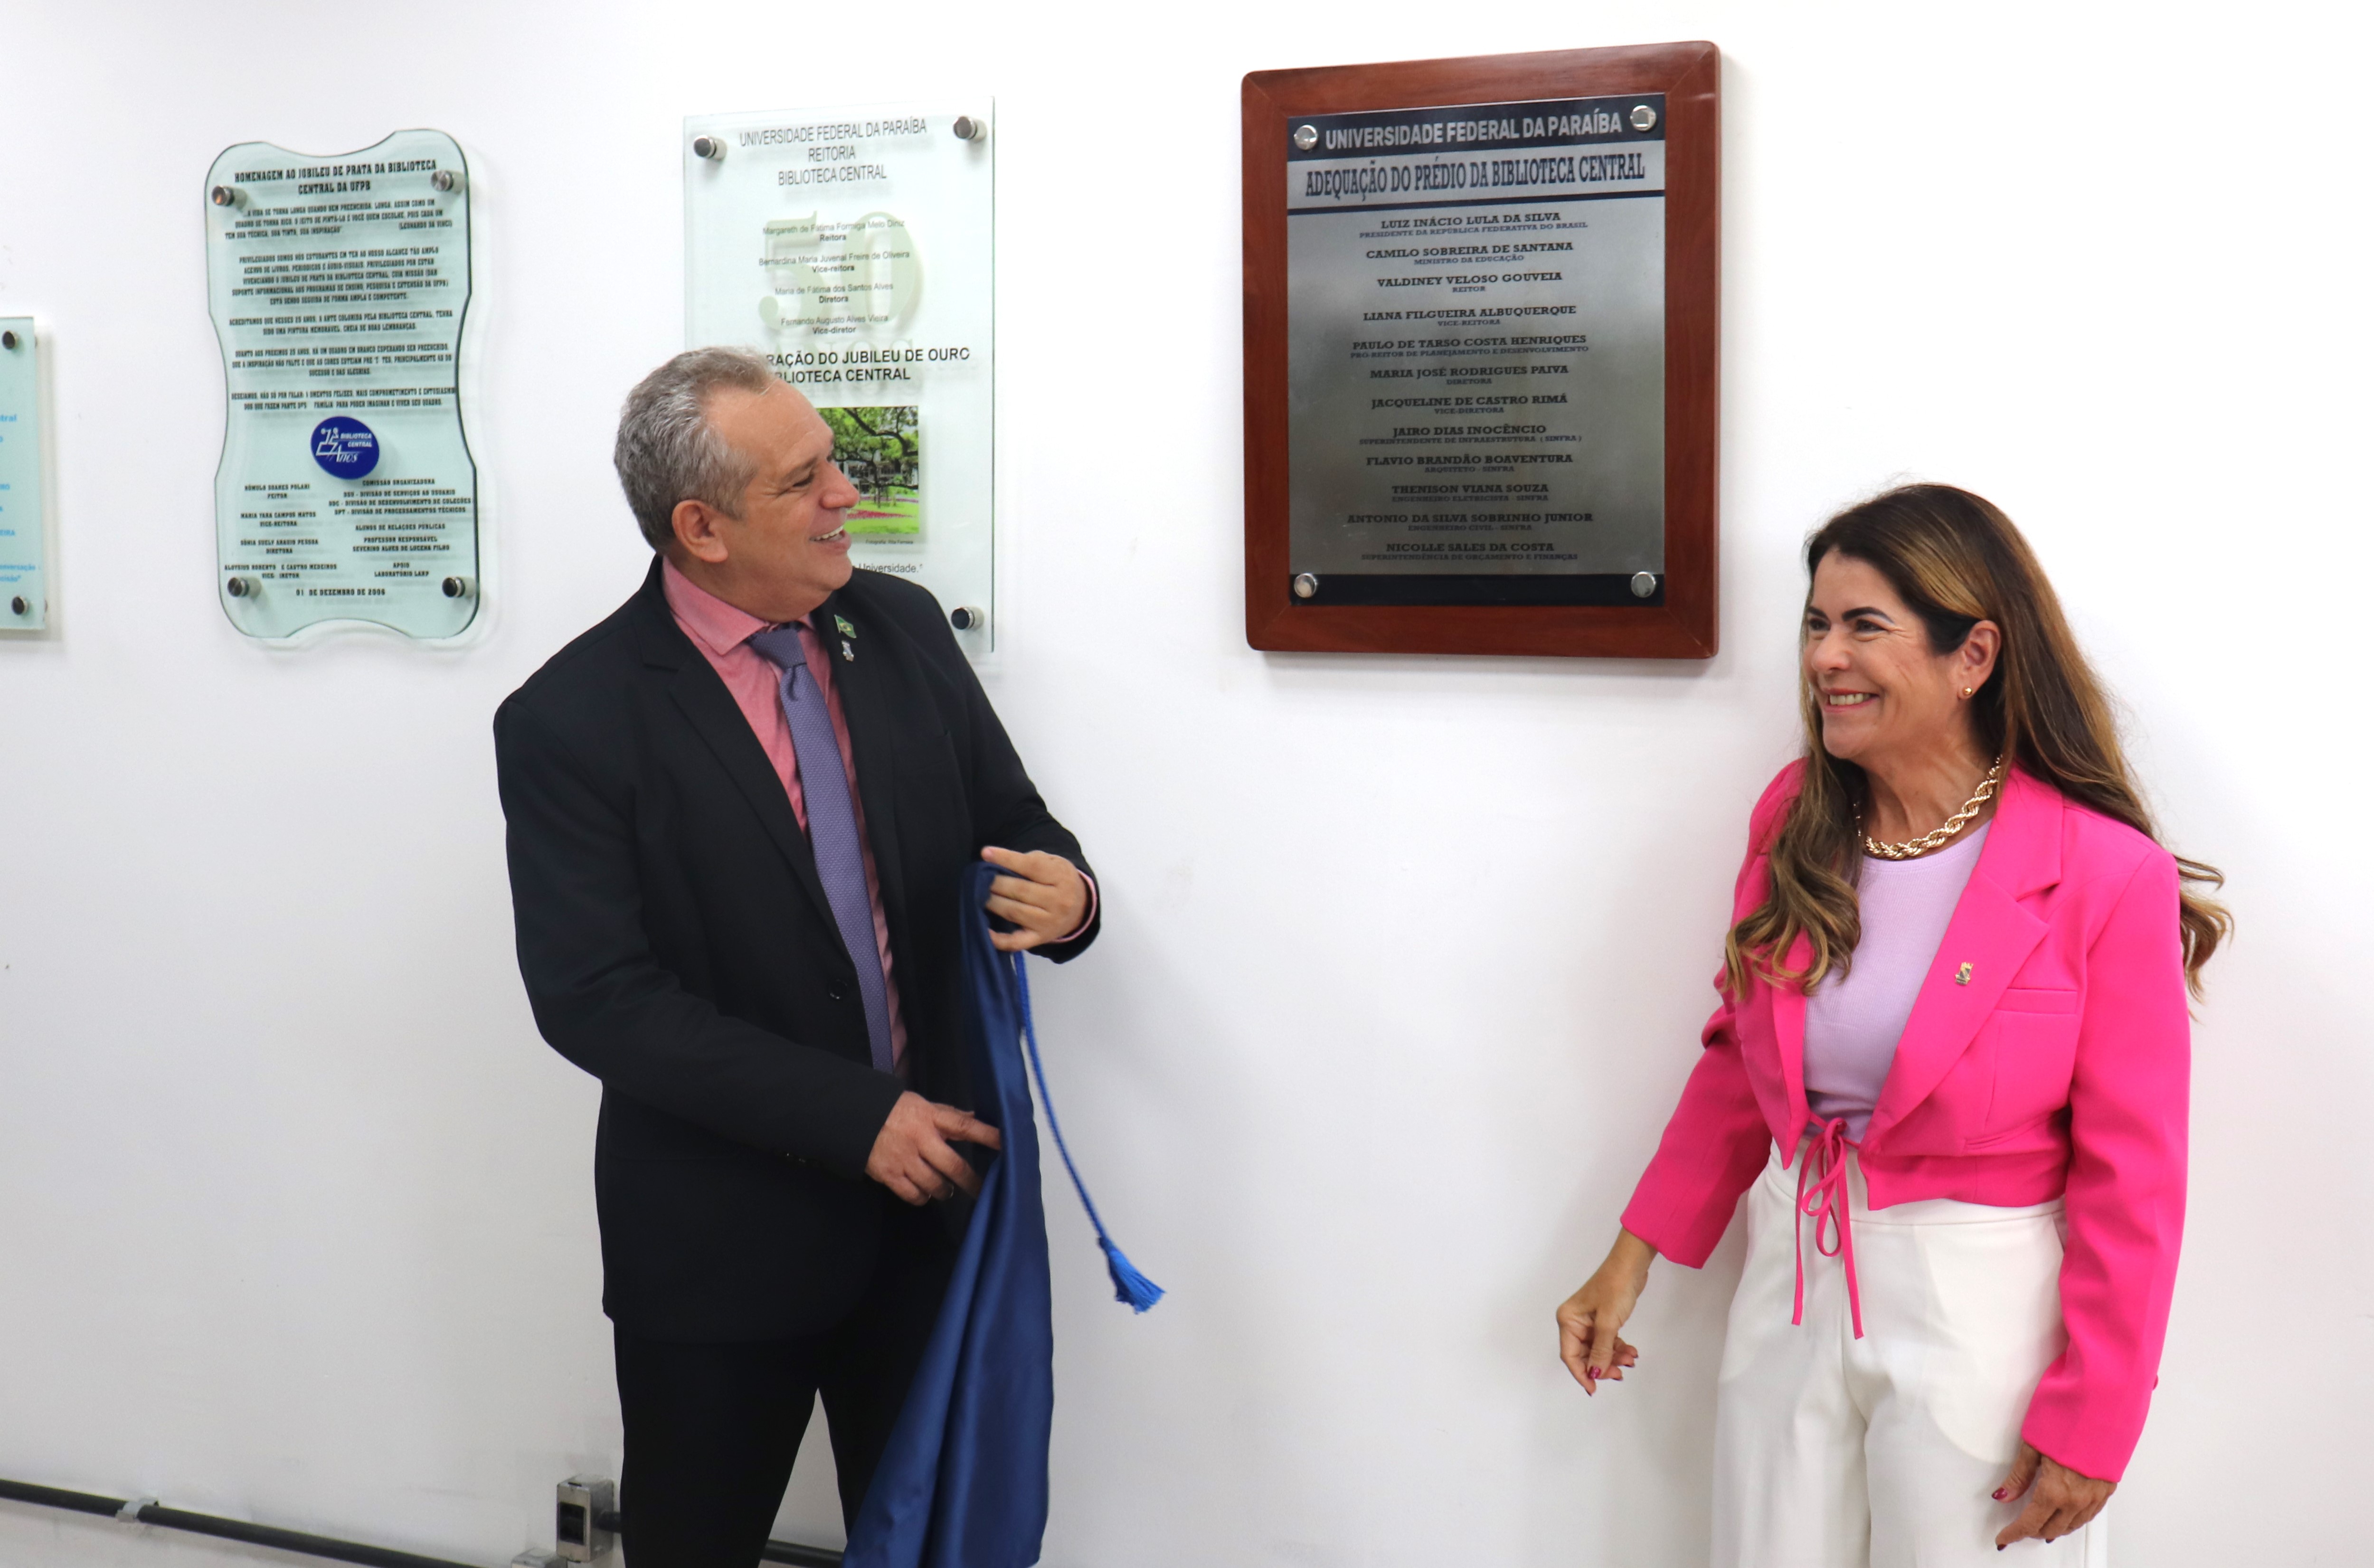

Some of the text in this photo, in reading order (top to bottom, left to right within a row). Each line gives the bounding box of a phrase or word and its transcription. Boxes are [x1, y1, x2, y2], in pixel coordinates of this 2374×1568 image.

[739, 116, 927, 147] UNIVERSIDADE FEDERAL DA PARAÍBA
[1326, 108, 1622, 150] UNIVERSIDADE FEDERAL DA PARAÍBA
[808, 145, 856, 162] REITORIA
[235, 170, 283, 183] HOMENAGEM
[286, 169, 295, 179] AO
[333, 166, 343, 176] DE
[346, 164, 371, 175] PRATA
[375, 163, 385, 174] DA
[388, 160, 436, 173] BIBLIOTECA
[778, 165, 886, 186] BIBLIOTECA CENTRAL
[1306, 152, 1645, 201] ADEQUAÇÃO DO PRÉDIO DA BIBLIOTECA CENTRAL
[298, 183, 334, 195] CENTRAL
[337, 182, 347, 192] DA
[1381, 212, 1561, 229] LUIZ INÁCIO LULA DA SILVA
[1359, 230, 1413, 238] PRESIDENTE
[1482, 224, 1537, 232] FEDERATIVA
[1366, 242, 1573, 259] CAMILO SOBREIRA DE SANTANA
[1475, 254, 1524, 263] EDUCAÇÃO
[812, 265, 855, 273] Vice-reitora
[1378, 272, 1562, 287] VALDINEY VELOSO GOUVEIA
[807, 285, 831, 293] Fátima
[848, 283, 871, 292] Santos
[819, 295, 849, 303] Diretora
[1363, 305, 1576, 321] LIANA FILGUEIRA ALBUQUERQUE
[781, 318, 815, 326] Fernando
[816, 317, 845, 326] Augusto
[812, 326, 856, 334] Vice-diretor
[1353, 335, 1586, 349] PAULO DE TARSO COSTA HENRIQUES
[818, 351, 838, 365] DO
[842, 350, 900, 364] JUBILEU
[905, 349, 923, 362] DE
[1420, 349, 1490, 357] PLANEJAMENTO
[1500, 346, 1589, 354] DESENVOLVIMENTO
[775, 368, 910, 383] LIOTECA CENTRAL
[1370, 365, 1569, 379] MARIA JOSÉ RODRIGUES PAIVA
[1372, 393, 1567, 409] JACQUELINE DE CASTRO RIMÁ
[1393, 424, 1546, 439] JAIRO DIAS INOCÊNCIO
[1417, 454, 1481, 464] BRANDÃO
[1485, 454, 1573, 464] BOAVENTURA
[1392, 484, 1549, 494] THENISON VIANA SOUZA
[1347, 513, 1593, 524] ANTONIO DA SILVA SOBRINHO JUNIOR
[1386, 543, 1554, 552] NICOLLE SALES DA COSTA
